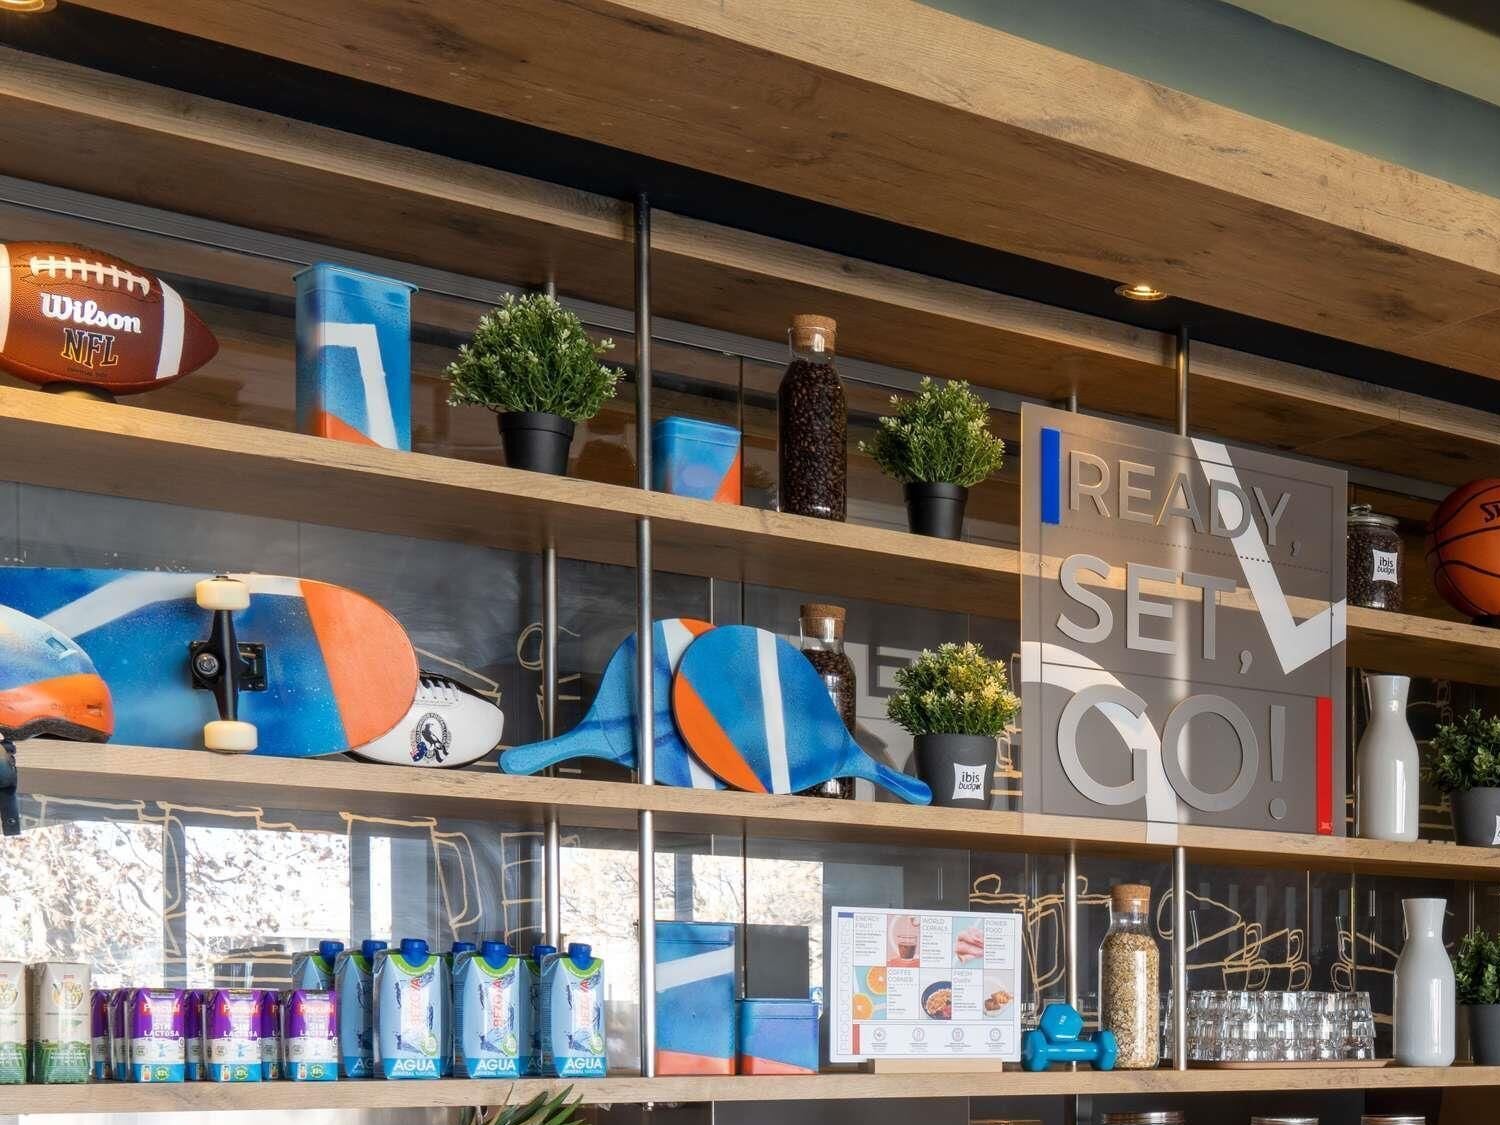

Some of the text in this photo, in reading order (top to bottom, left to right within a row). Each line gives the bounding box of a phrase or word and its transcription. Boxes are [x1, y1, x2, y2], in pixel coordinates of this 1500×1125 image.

[40, 292, 142, 334] Wilson
[61, 327, 119, 369] NFL
[1070, 450, 1298, 556] READY,
[1379, 556, 1394, 567] ibis
[1056, 554, 1253, 674] SET,
[1057, 683, 1287, 821] GO!
[961, 771, 980, 782] ibis
[922, 917, 945, 925] WORLD
[393, 1059, 437, 1071] AGUA
[476, 1059, 517, 1071] AGUA
[565, 1058, 603, 1069] AGUA
